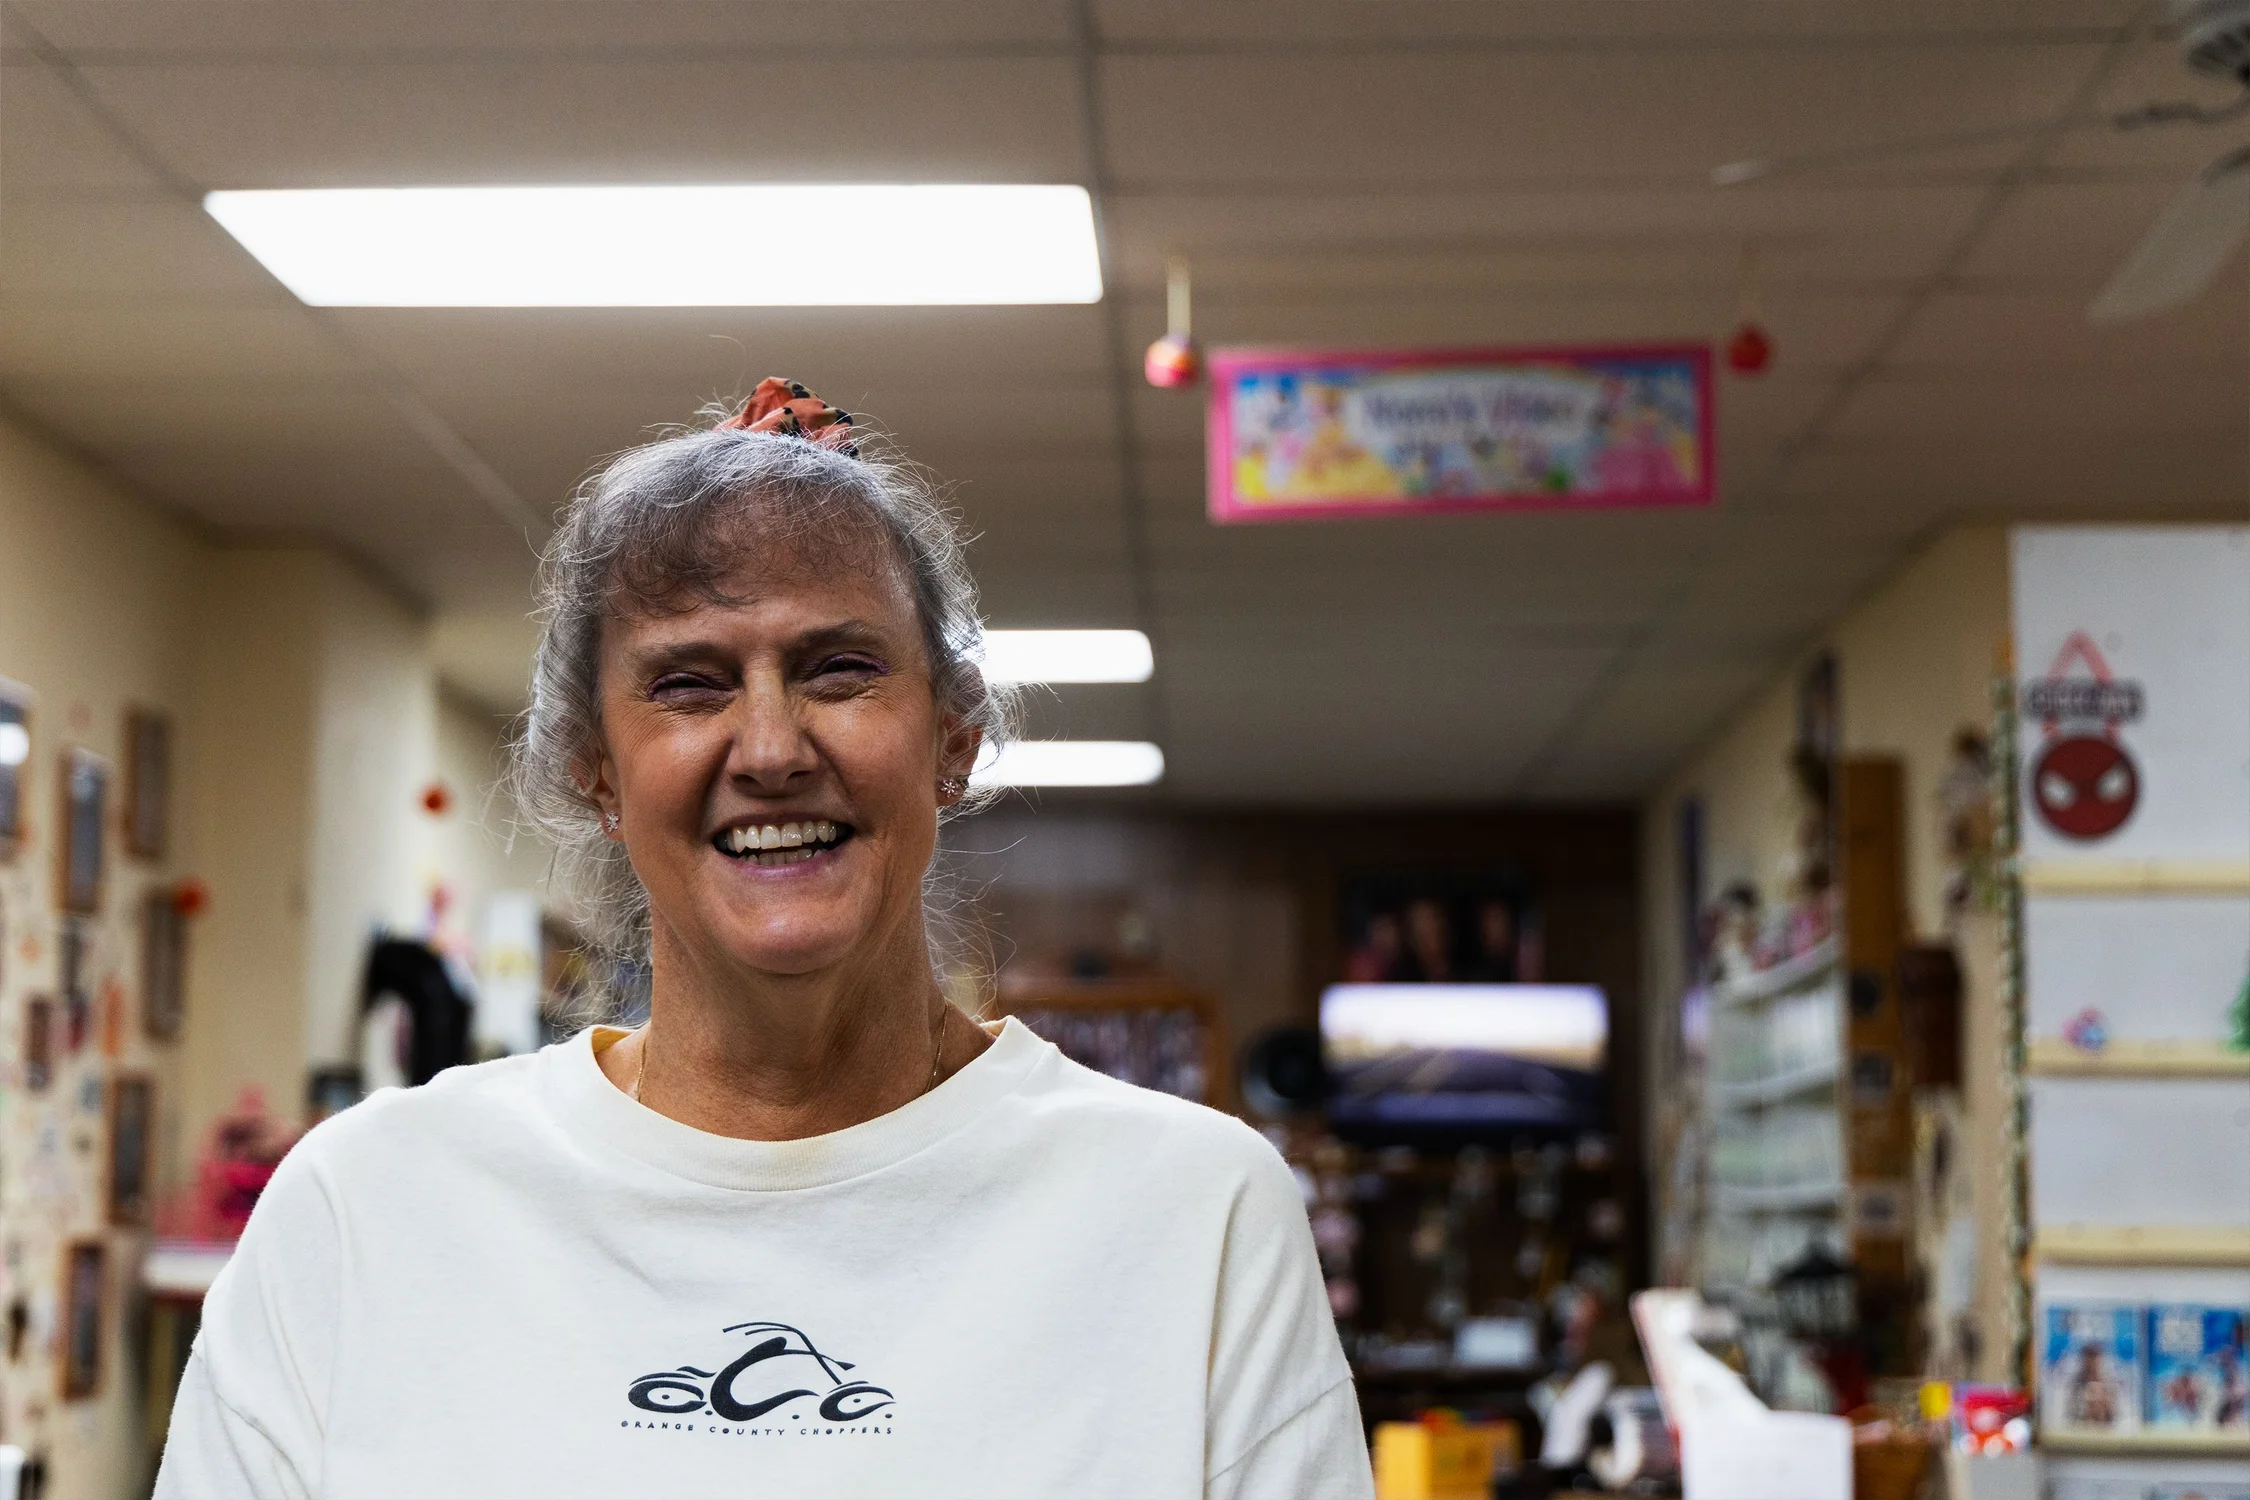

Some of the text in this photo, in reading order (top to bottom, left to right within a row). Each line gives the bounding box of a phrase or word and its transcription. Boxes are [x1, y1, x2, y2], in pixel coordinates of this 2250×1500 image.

[620, 1420, 893, 1436] ORANGE COUNTY CHOPPERS
